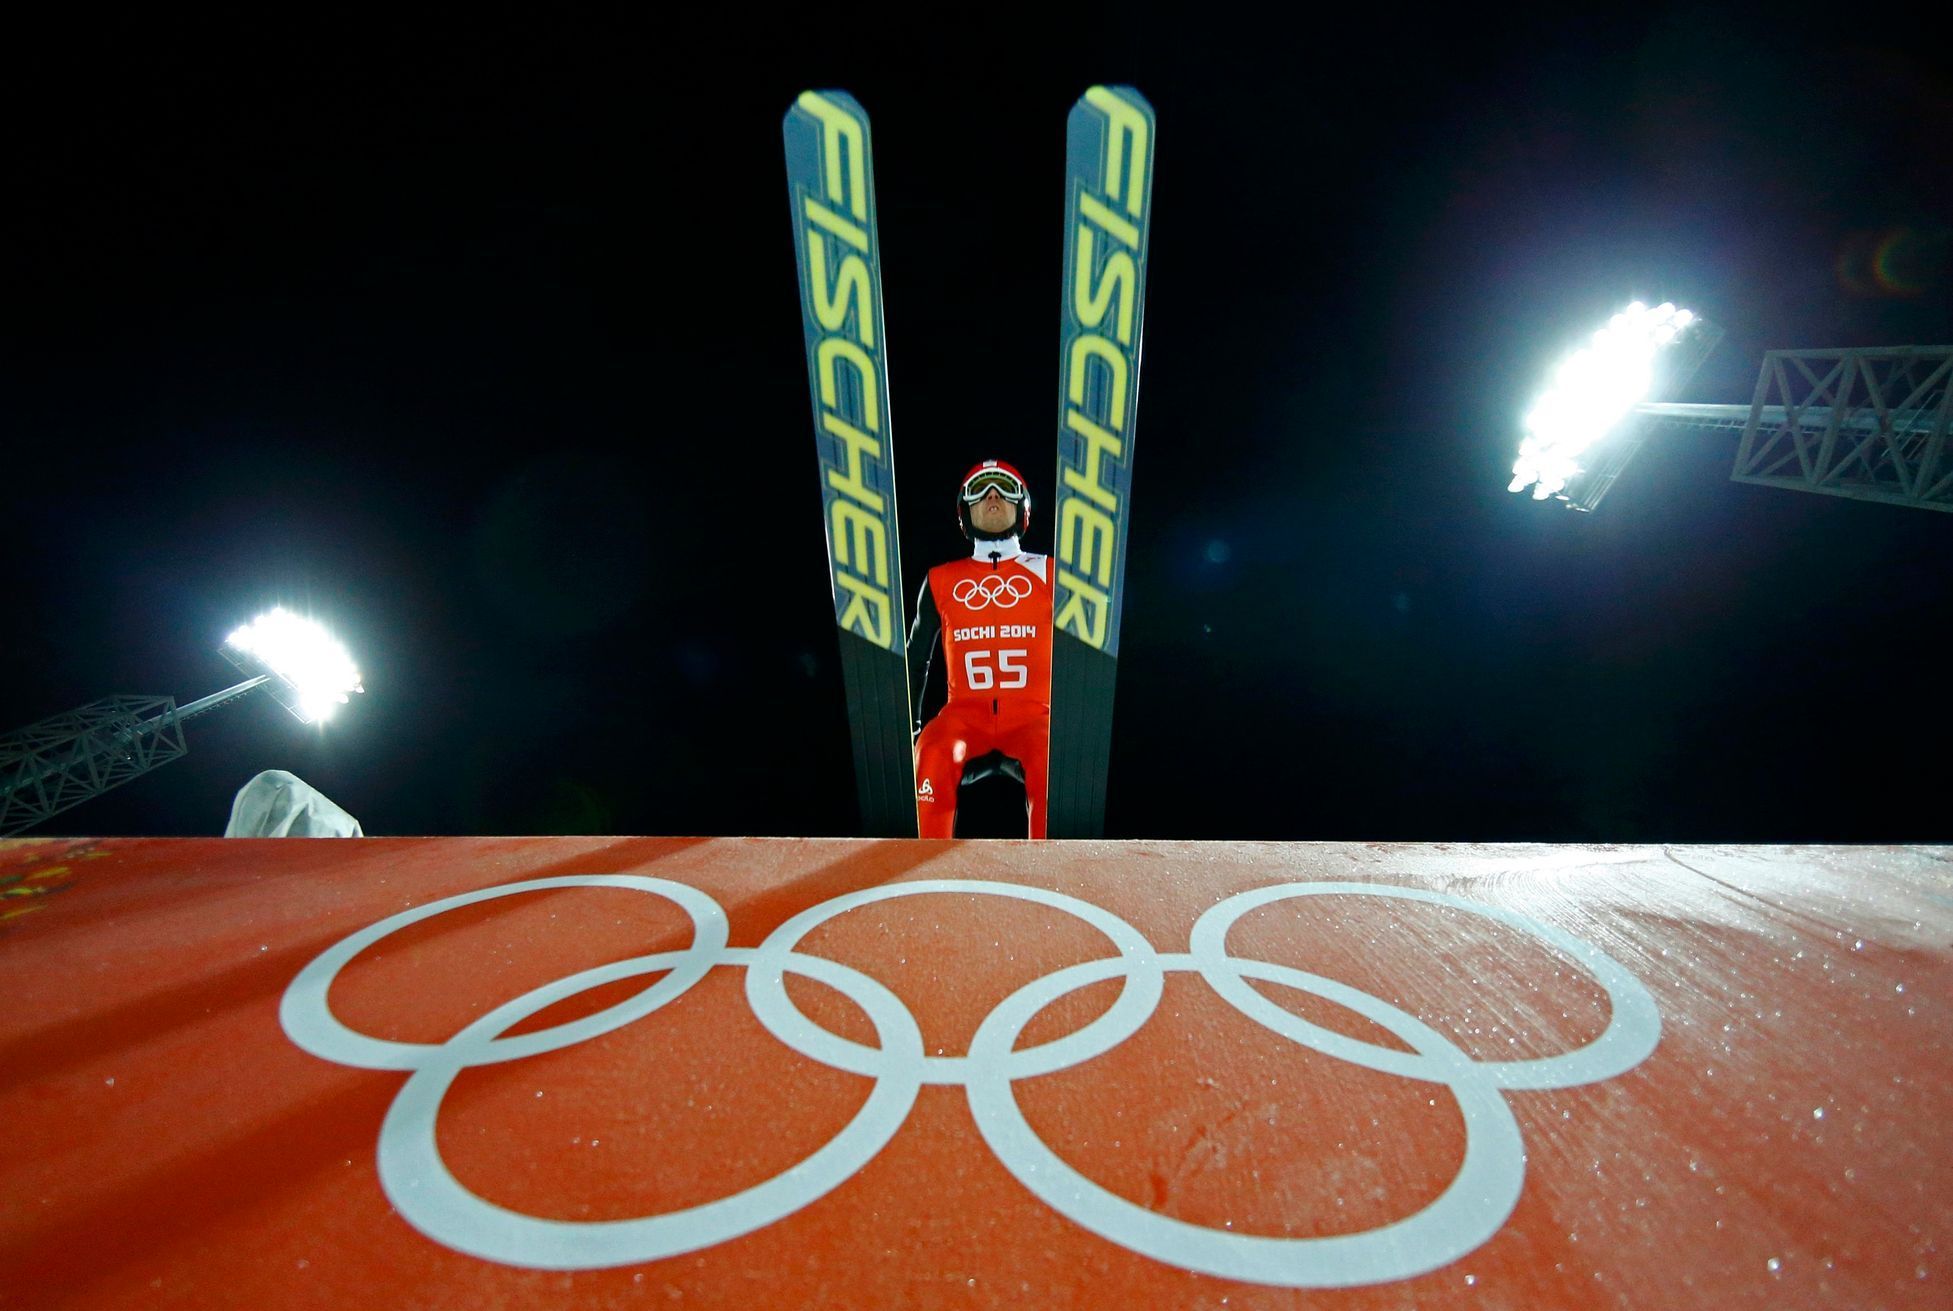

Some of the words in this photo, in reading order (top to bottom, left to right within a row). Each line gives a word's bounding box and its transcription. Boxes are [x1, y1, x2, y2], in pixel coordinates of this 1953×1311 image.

[797, 91, 892, 650] FISCHER
[1055, 86, 1148, 650] FISCHER
[953, 626, 996, 642] SOCHI
[1000, 625, 1036, 638] 2014
[964, 649, 1028, 690] 65
